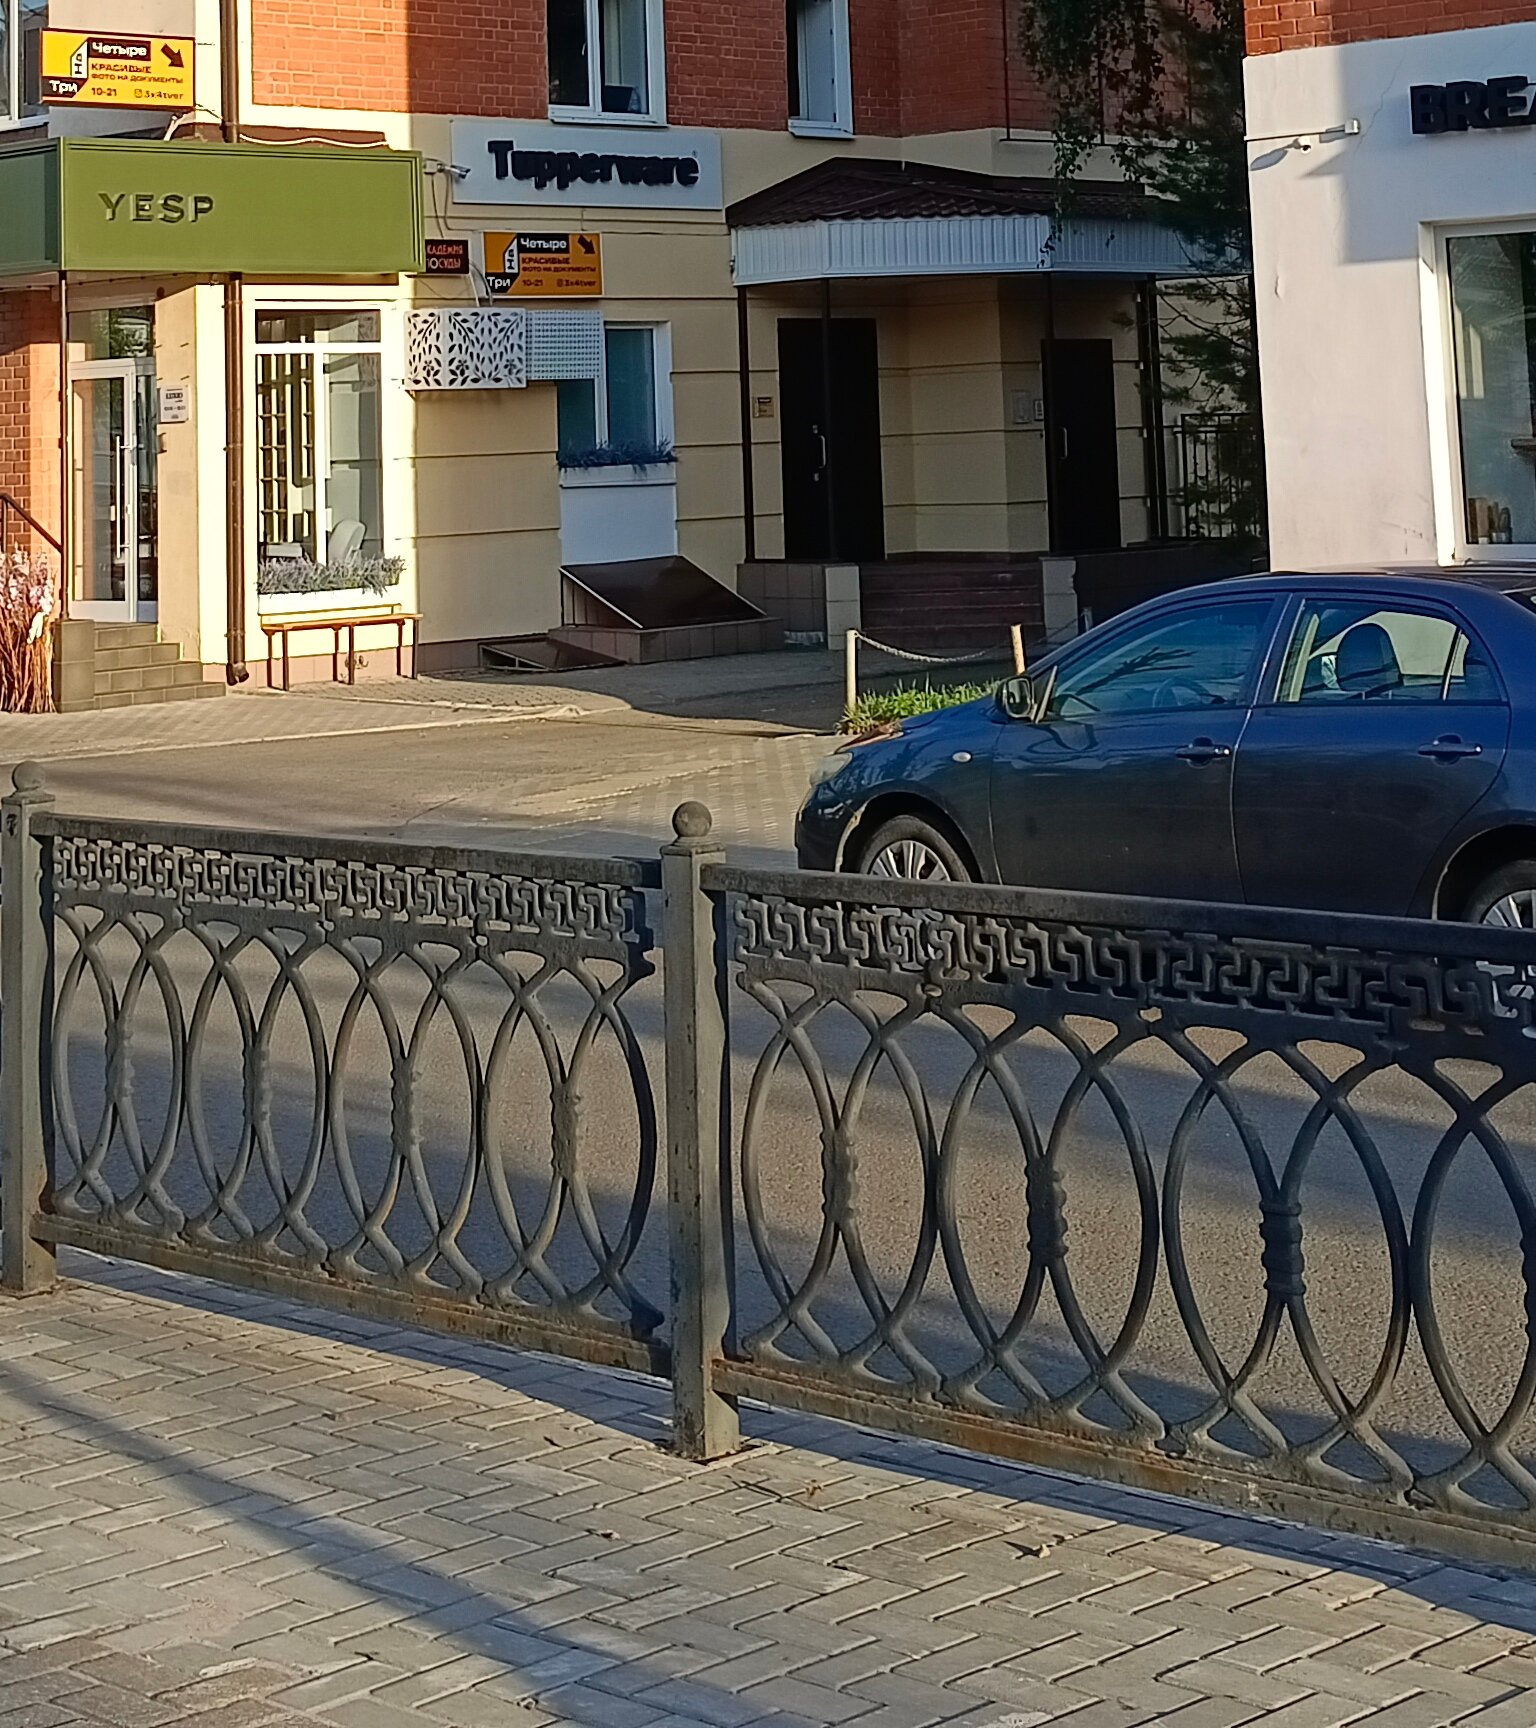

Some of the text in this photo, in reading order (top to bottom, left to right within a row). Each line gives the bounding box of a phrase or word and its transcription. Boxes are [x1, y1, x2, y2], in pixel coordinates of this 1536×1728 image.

[92, 42, 147, 57] Четыре
[49, 80, 78, 94] Три
[91, 87, 117, 97] 10-21
[487, 140, 700, 190] Tupperware
[97, 192, 215, 223] YESP
[520, 238, 567, 252] Четыре
[521, 257, 571, 265] КРАСИВЫЕ
[486, 276, 511, 289] Три
[521, 279, 544, 287] 10-21
